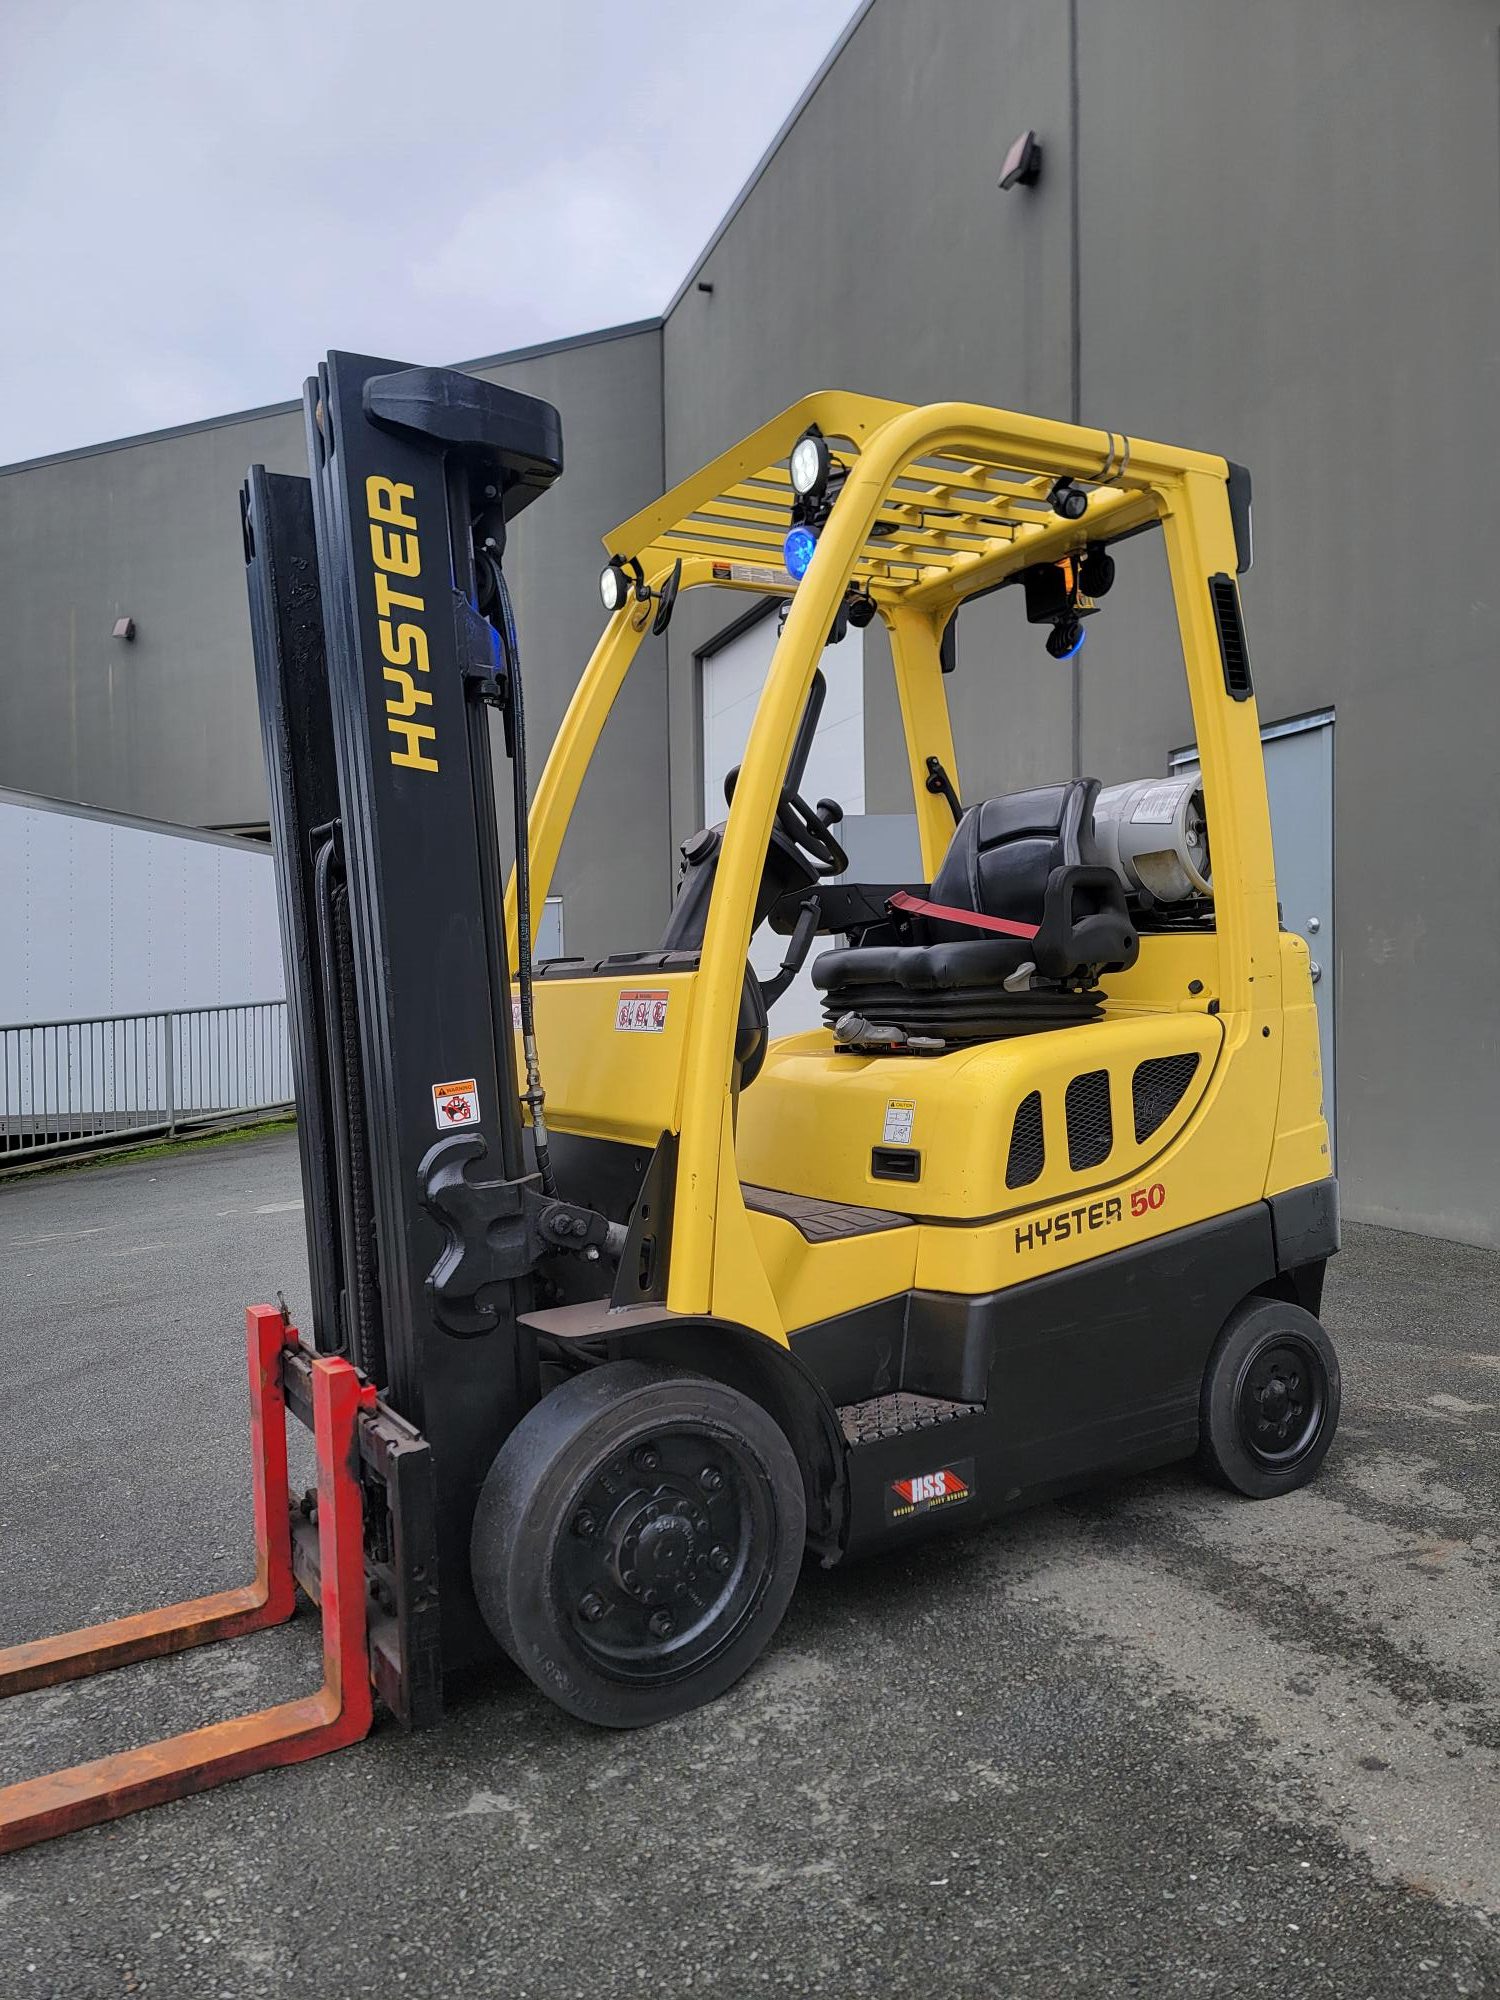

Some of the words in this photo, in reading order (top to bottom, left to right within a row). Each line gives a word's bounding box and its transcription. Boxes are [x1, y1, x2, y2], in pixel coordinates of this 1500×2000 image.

[366, 475, 439, 773] HYSTER
[1015, 1197, 1122, 1254] HYSTER
[1130, 1183, 1166, 1217] 50
[911, 1471, 946, 1504] HSS
